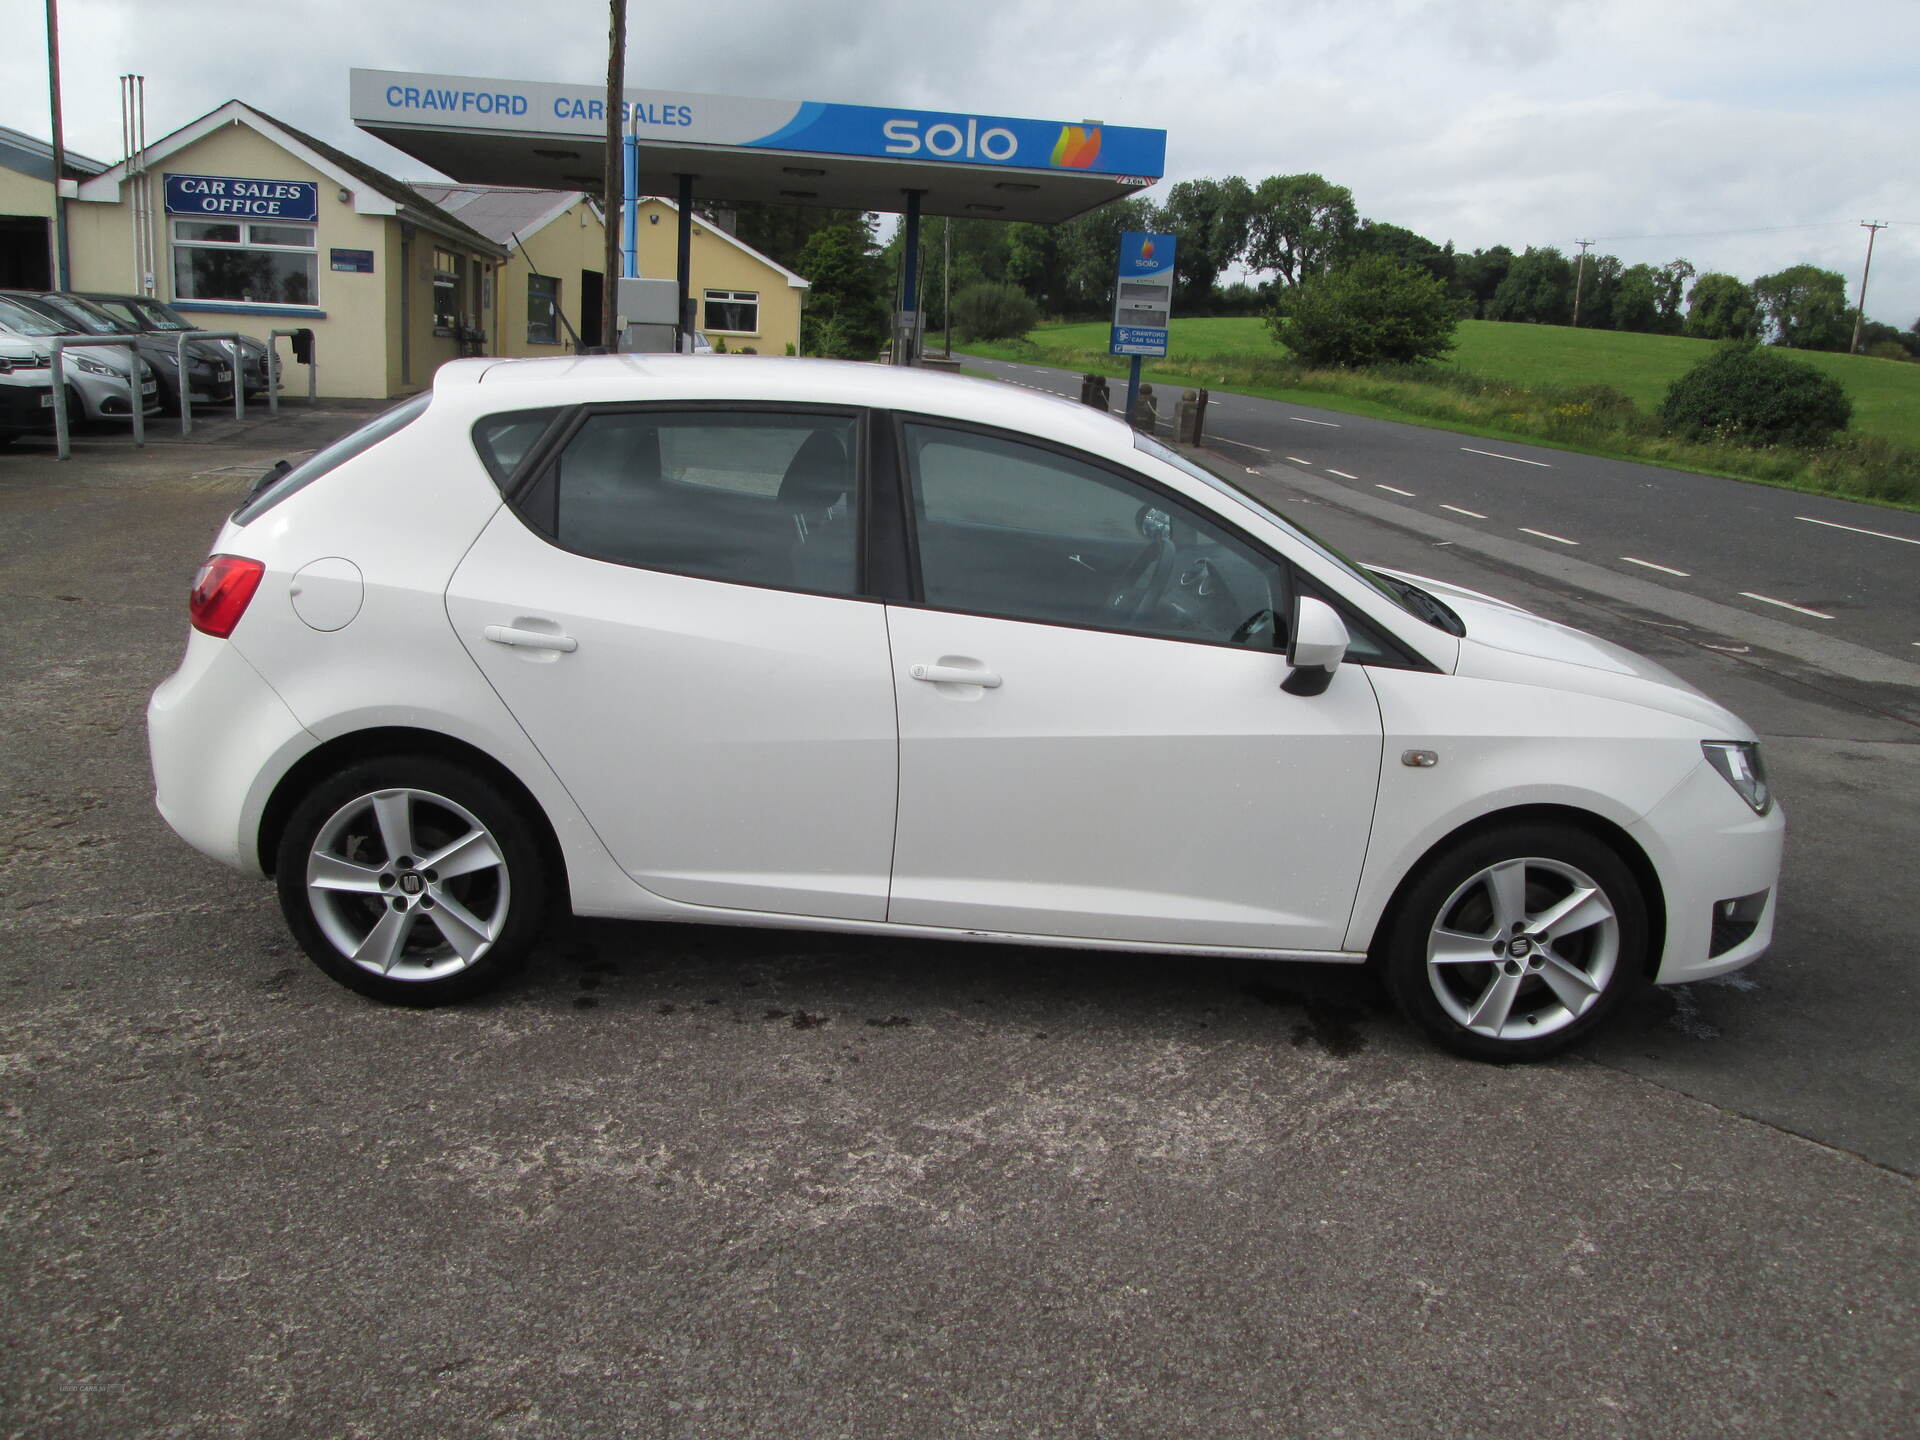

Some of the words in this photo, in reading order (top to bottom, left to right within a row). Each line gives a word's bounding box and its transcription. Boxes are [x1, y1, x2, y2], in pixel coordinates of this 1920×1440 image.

[386, 85, 528, 116] CRAWFORD
[553, 97, 604, 121] CAR
[883, 118, 1018, 160] solo
[180, 180, 226, 195] CAR
[232, 183, 301, 200] SALES
[202, 197, 281, 215] OFFICE
[1135, 259, 1159, 268] solo
